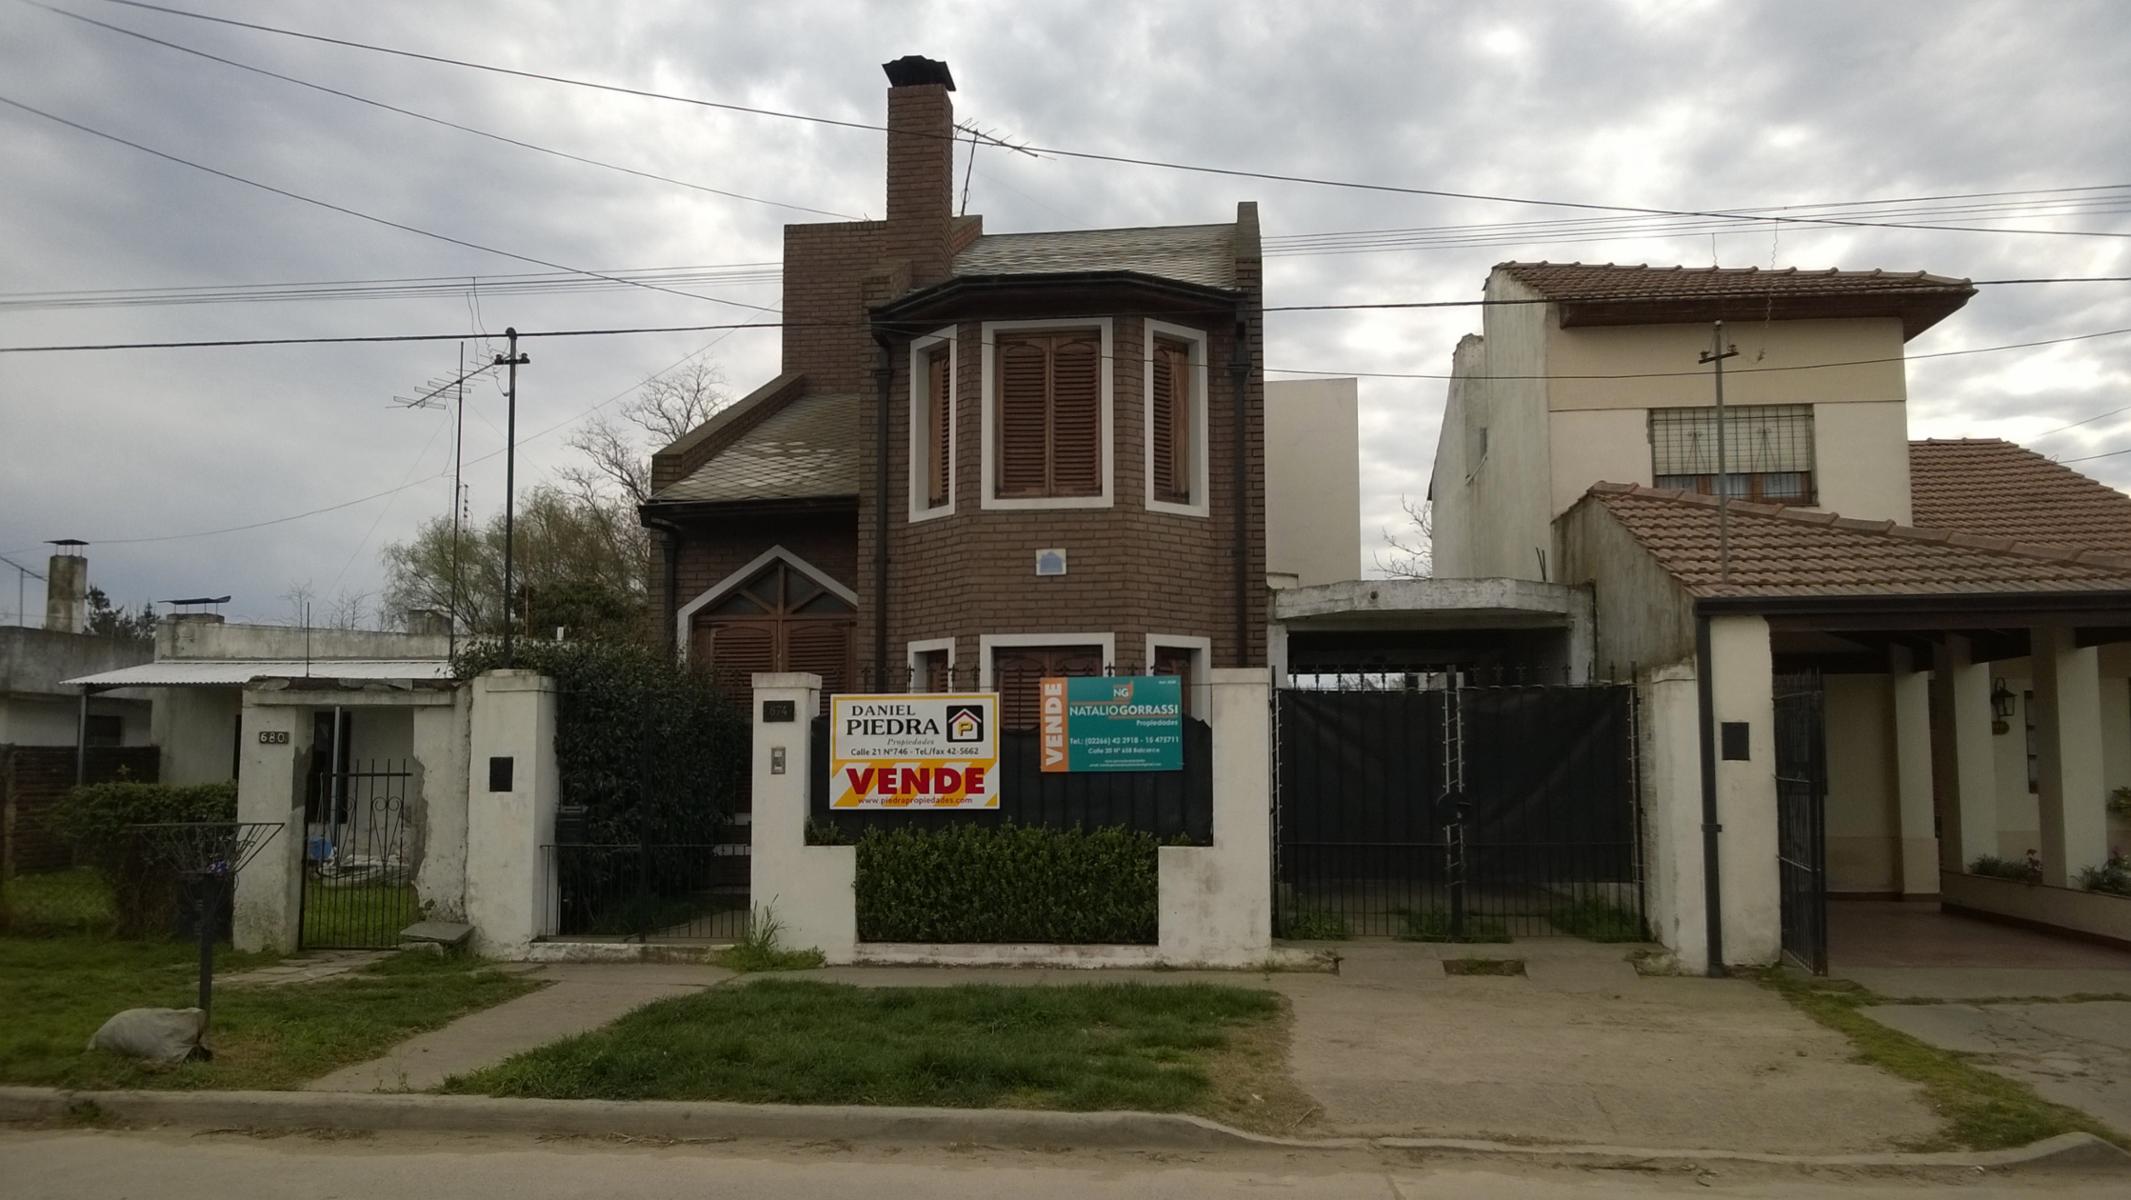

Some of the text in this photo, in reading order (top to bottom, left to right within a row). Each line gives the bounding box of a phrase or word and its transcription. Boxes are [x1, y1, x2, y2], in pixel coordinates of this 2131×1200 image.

[1113, 688, 1129, 697] NG
[852, 705, 916, 716] DANIEL
[846, 718, 940, 736] PIEDRA
[1044, 683, 1063, 767] VENDE
[1136, 720, 1178, 728] Propiedades
[260, 732, 285, 743] 680
[887, 738, 935, 746] Propiedades
[850, 748, 870, 756] Calle
[872, 748, 882, 756] 21
[846, 768, 985, 795] VENDE
